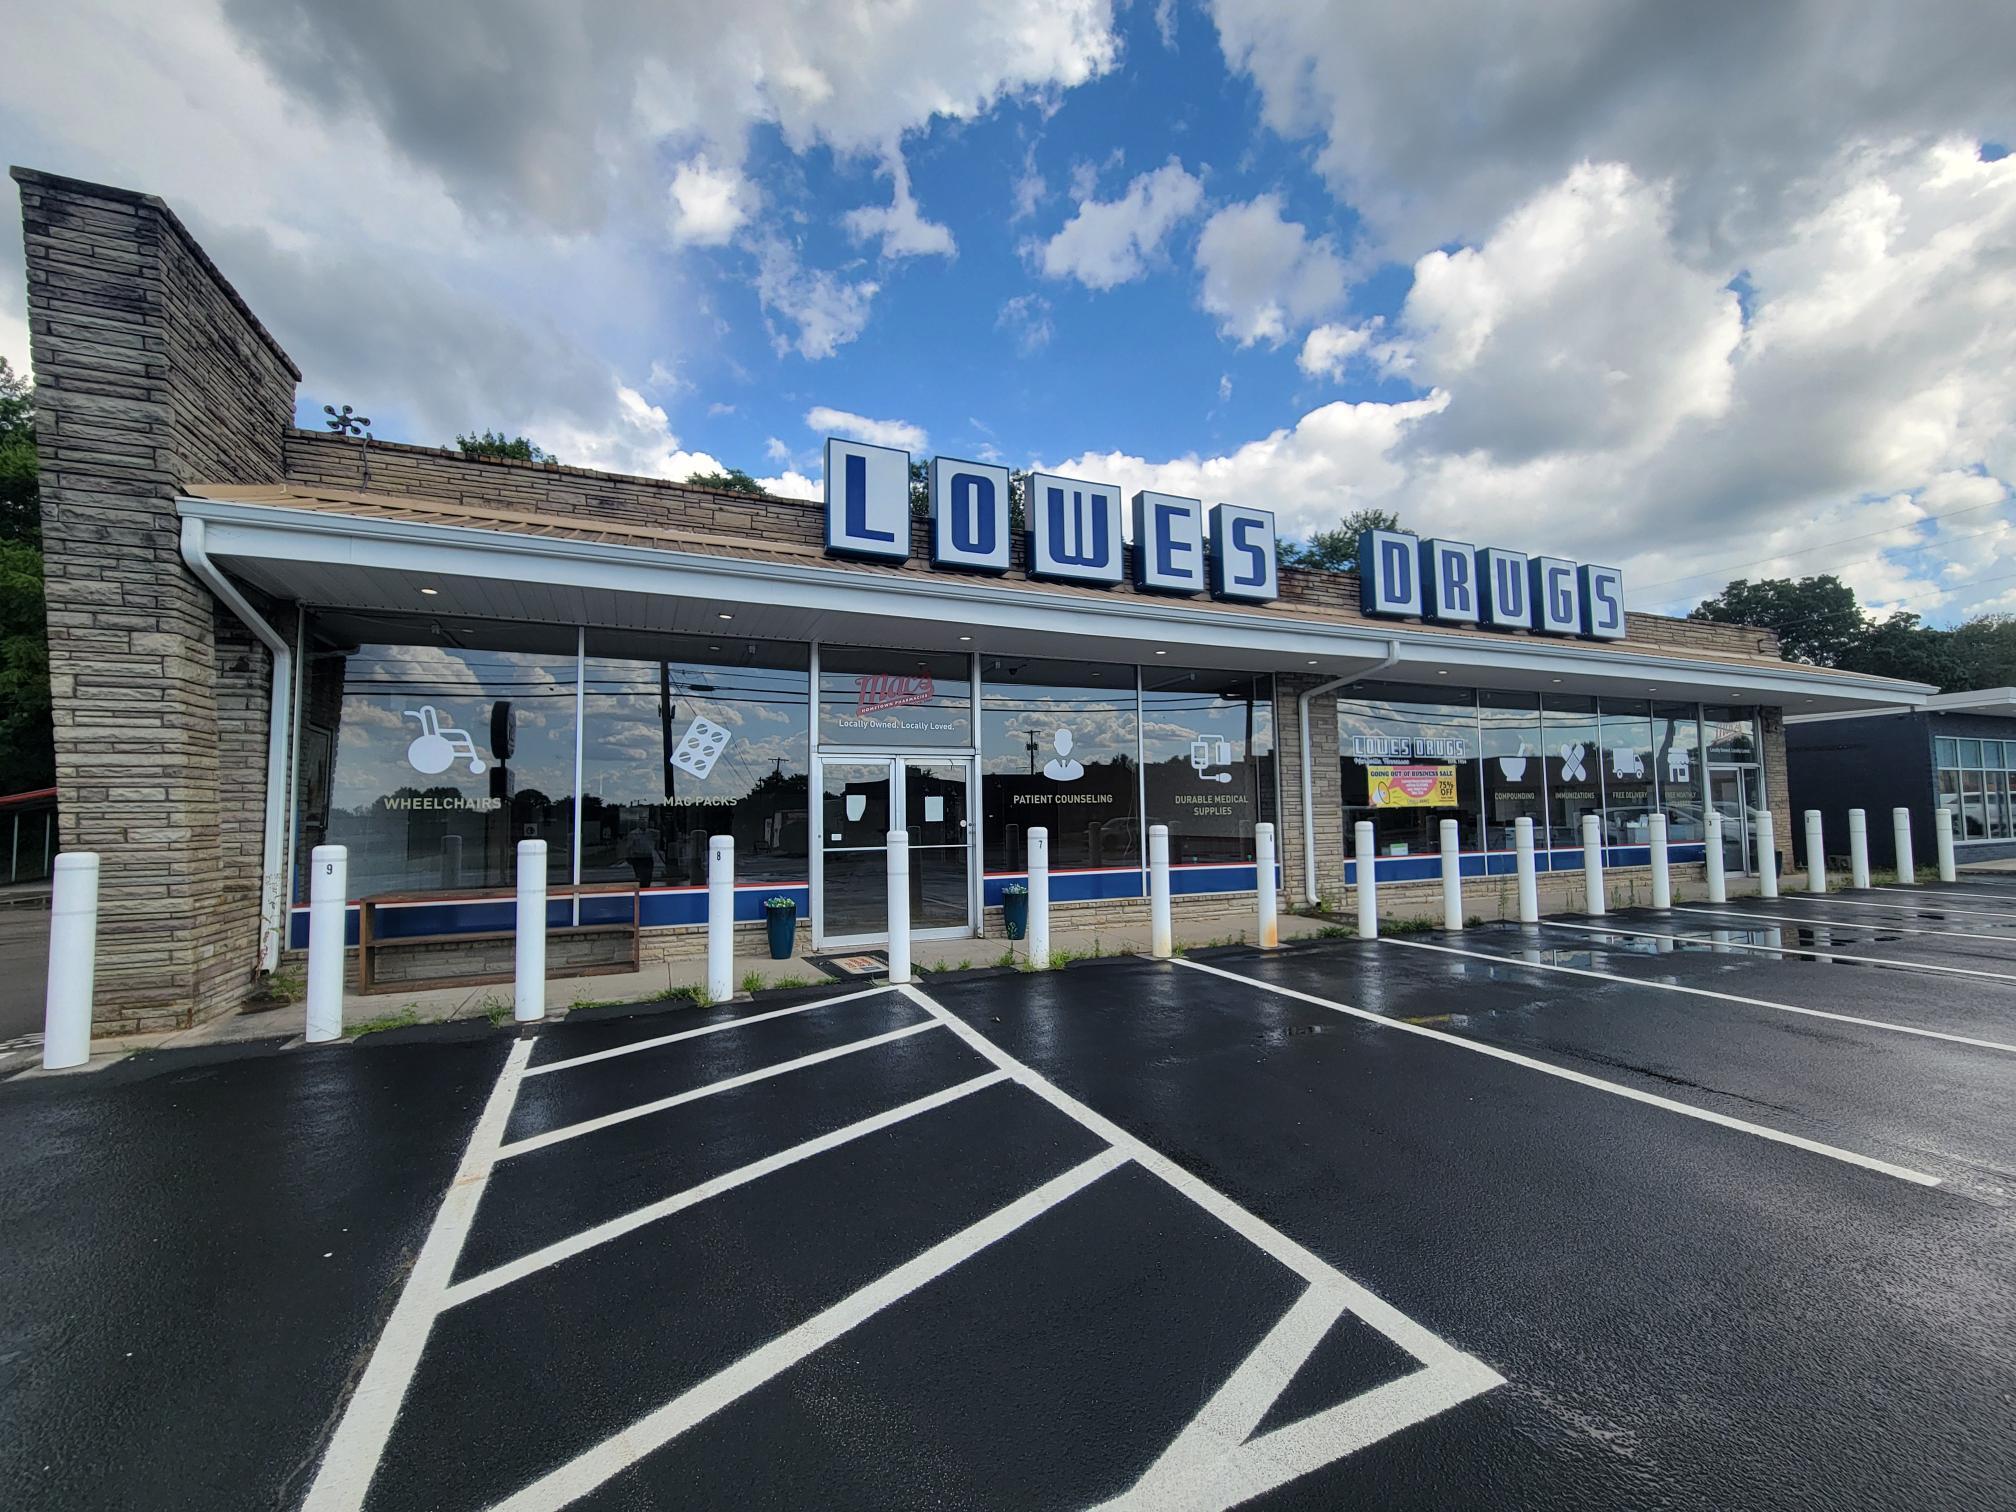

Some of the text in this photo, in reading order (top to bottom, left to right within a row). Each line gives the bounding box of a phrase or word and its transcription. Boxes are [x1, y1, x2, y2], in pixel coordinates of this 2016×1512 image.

[845, 454, 1619, 630] LOWES DRUGS
[839, 719, 955, 731] Locally Owned. Locally Loved.
[1354, 738, 1463, 756] LOWES DRUGS
[1439, 780, 1454, 789] 75%
[1440, 788, 1453, 796] OFF
[1494, 792, 1535, 800] COMPOUNDING
[1555, 791, 1595, 799] IMMUNIZATIONS
[1612, 791, 1648, 799] FREE DELIVERY
[383, 797, 502, 810] WHEELCHAIRS
[663, 795, 738, 807] MAC PACKS
[1013, 794, 1113, 804] PATIENT COUNSELING
[1175, 794, 1249, 804] DURABLE MEDICAL
[1193, 806, 1232, 816] SUPPLIES
[1038, 839, 1043, 849] 7
[716, 850, 721, 861] 8
[326, 863, 333, 875] 9
